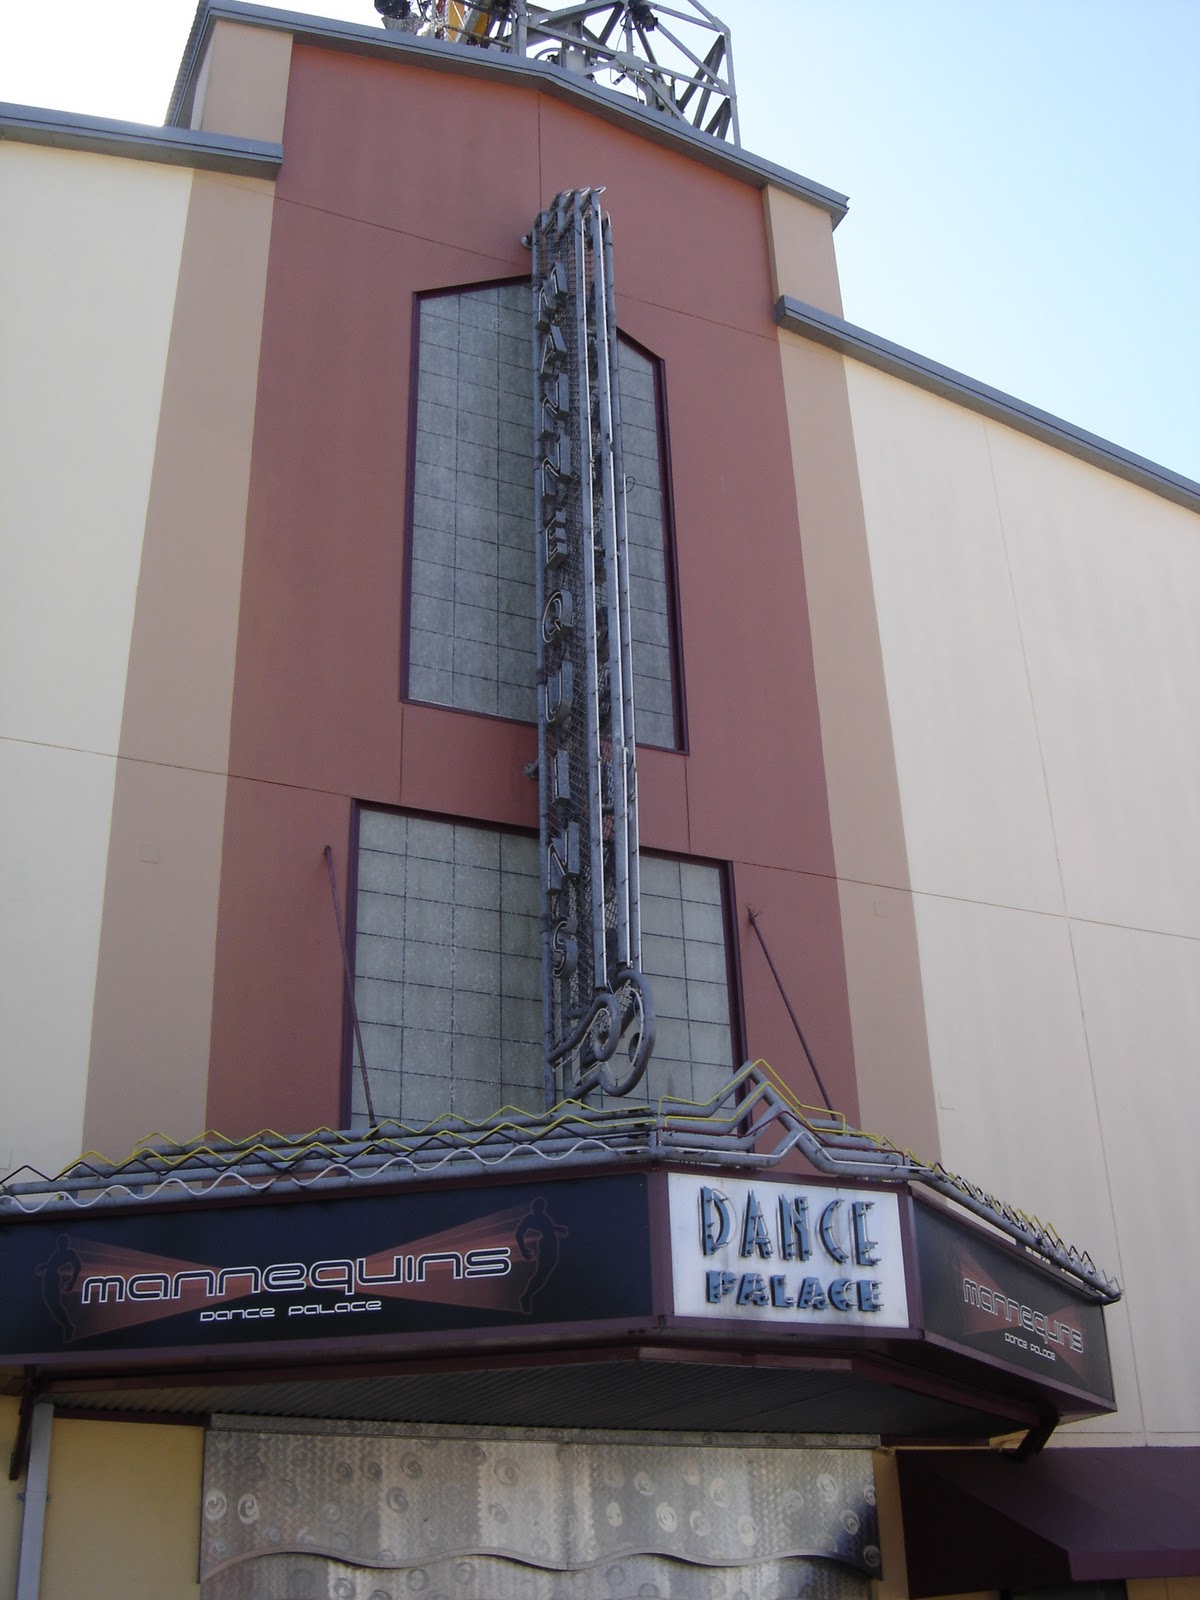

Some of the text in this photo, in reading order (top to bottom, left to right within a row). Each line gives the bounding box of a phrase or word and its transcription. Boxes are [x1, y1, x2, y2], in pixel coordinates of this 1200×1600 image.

[536, 261, 580, 978] MANNEQUINS
[699, 1185, 881, 1266] DANCE
[81, 1246, 512, 1303] mannequins
[705, 1269, 884, 1312] PALACE
[962, 1277, 1083, 1353] mannequins
